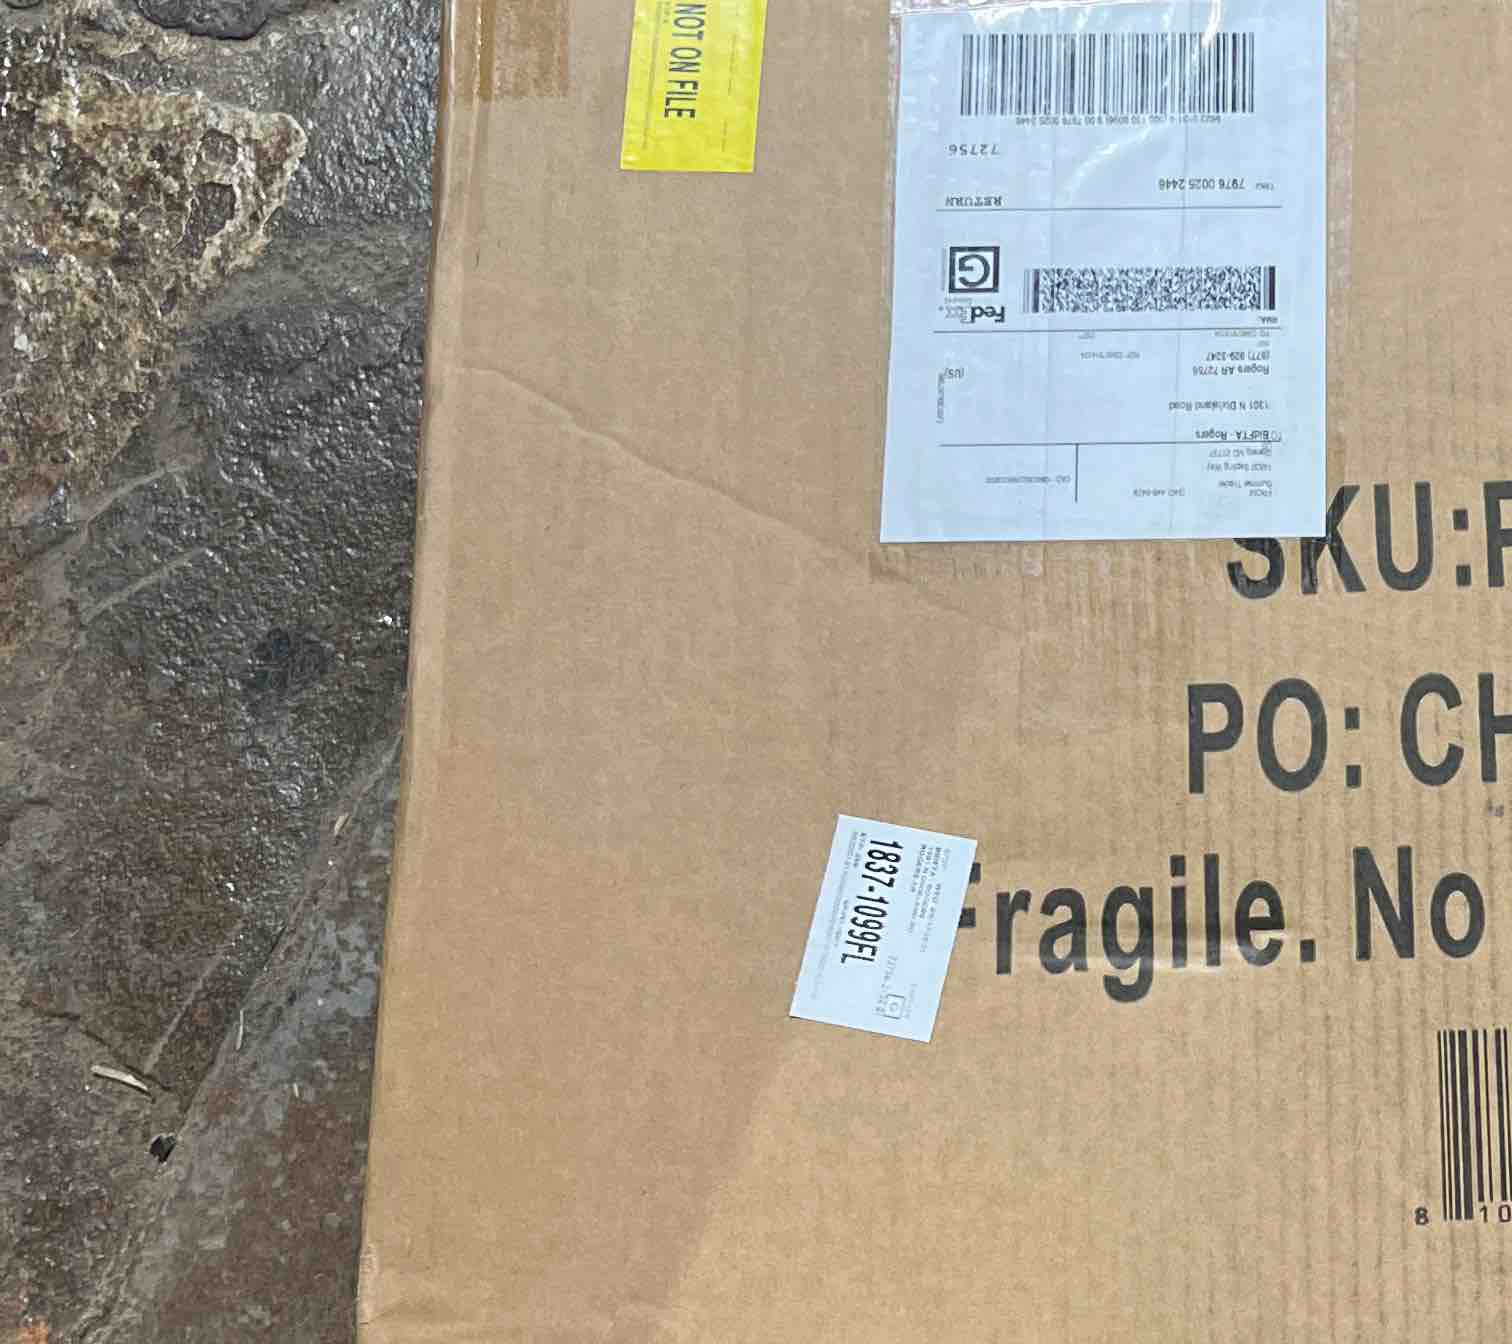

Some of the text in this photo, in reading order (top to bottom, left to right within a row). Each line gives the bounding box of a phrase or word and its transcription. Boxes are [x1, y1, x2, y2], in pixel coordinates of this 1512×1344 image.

[664, 3, 707, 119] NOT ON FILE
[948, 143, 999, 156] 72756
[1187, 177, 1216, 191] 0025
[1219, 177, 1247, 191] 7976
[945, 195, 1003, 207] RETURN
[958, 253, 991, 288] G
[1237, 363, 1270, 375] Rogers
[1195, 429, 1228, 441] Rogers
[1187, 677, 1362, 794] PO:
[840, 839, 904, 964] 1837-1099FL
[957, 853, 1317, 1003] ragile.
[1353, 845, 1486, 961] No
[1414, 1206, 1430, 1226] 8
